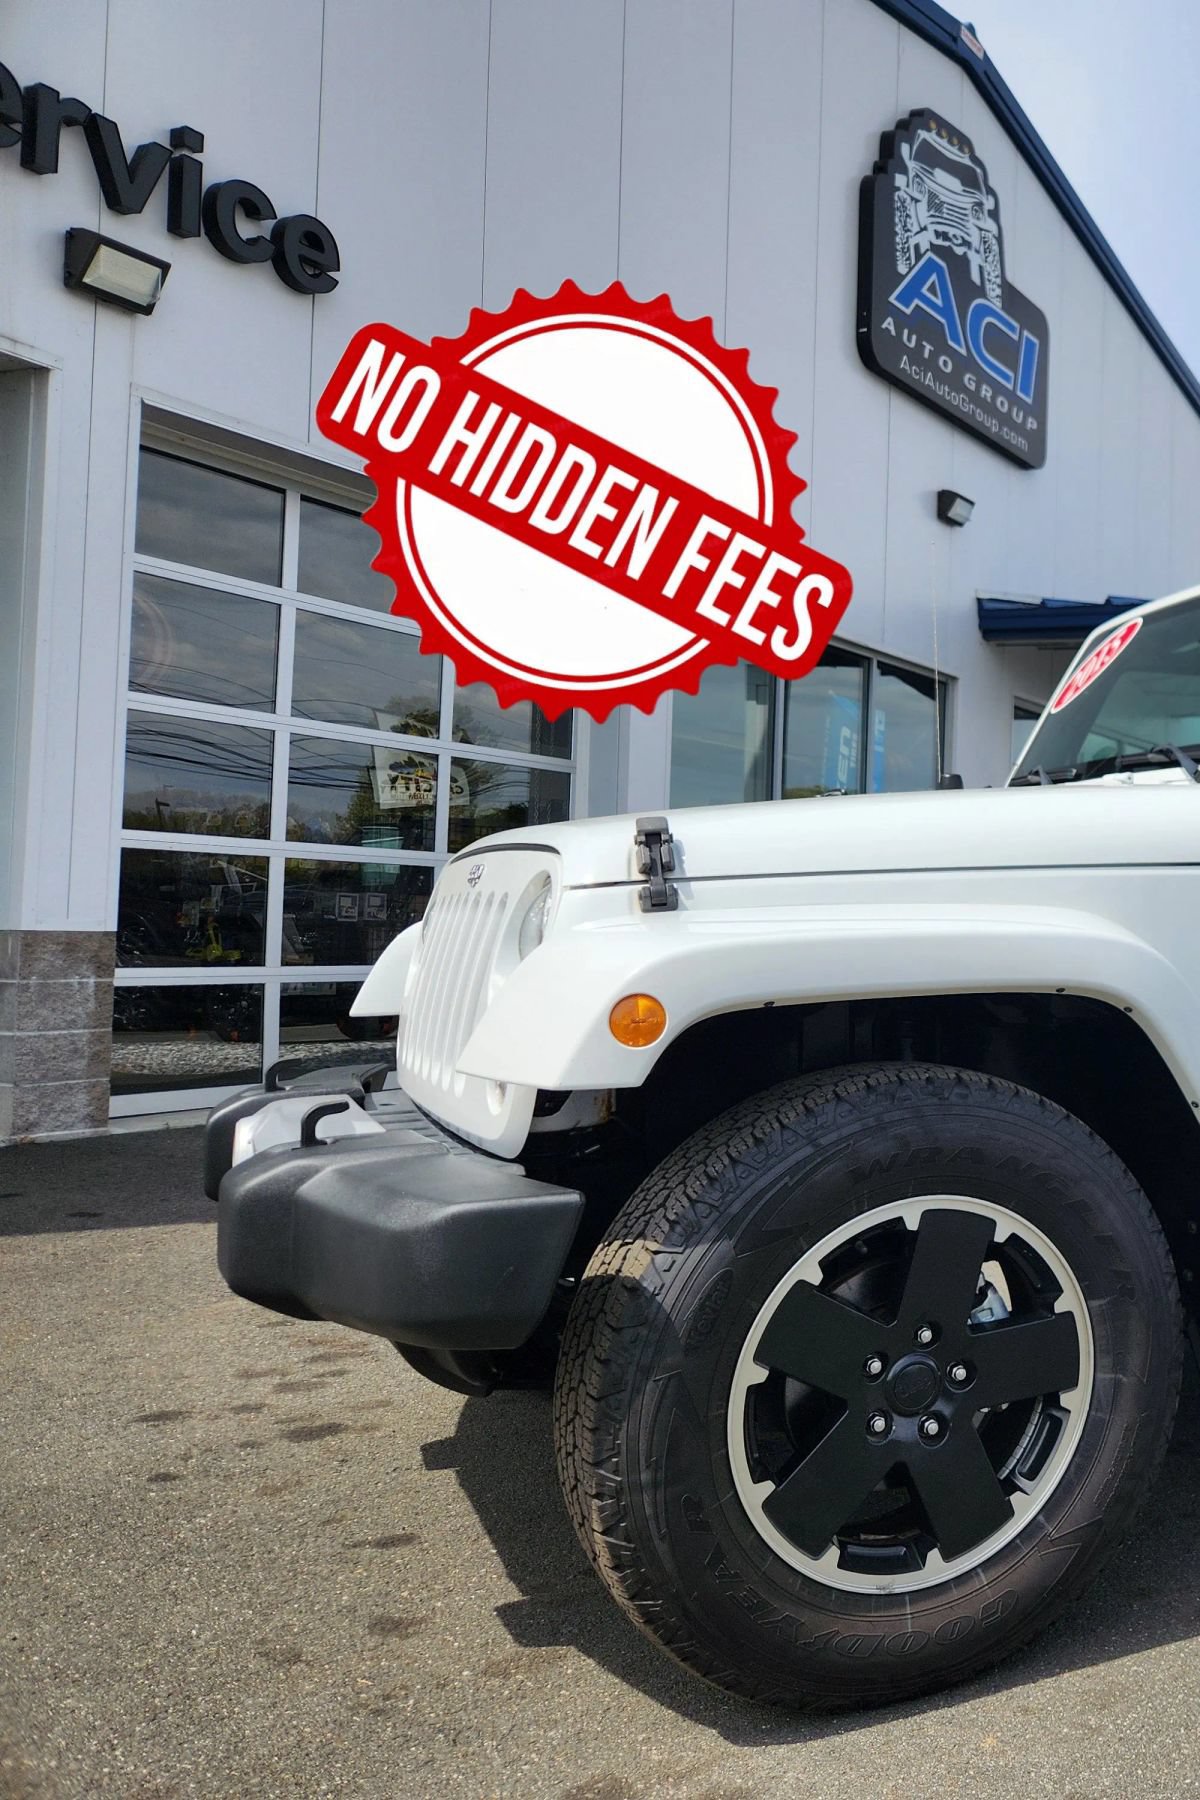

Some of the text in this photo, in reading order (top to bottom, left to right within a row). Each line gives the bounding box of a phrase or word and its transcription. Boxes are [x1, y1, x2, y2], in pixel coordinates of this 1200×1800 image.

[881, 316, 1038, 431] AUTO GROUP
[888, 251, 1040, 405] ACI
[900, 354, 1029, 452] AciAutoGroup.com
[848, 1144, 1138, 1303] WRANGLER
[680, 1490, 1022, 1659] GOODYEAR
